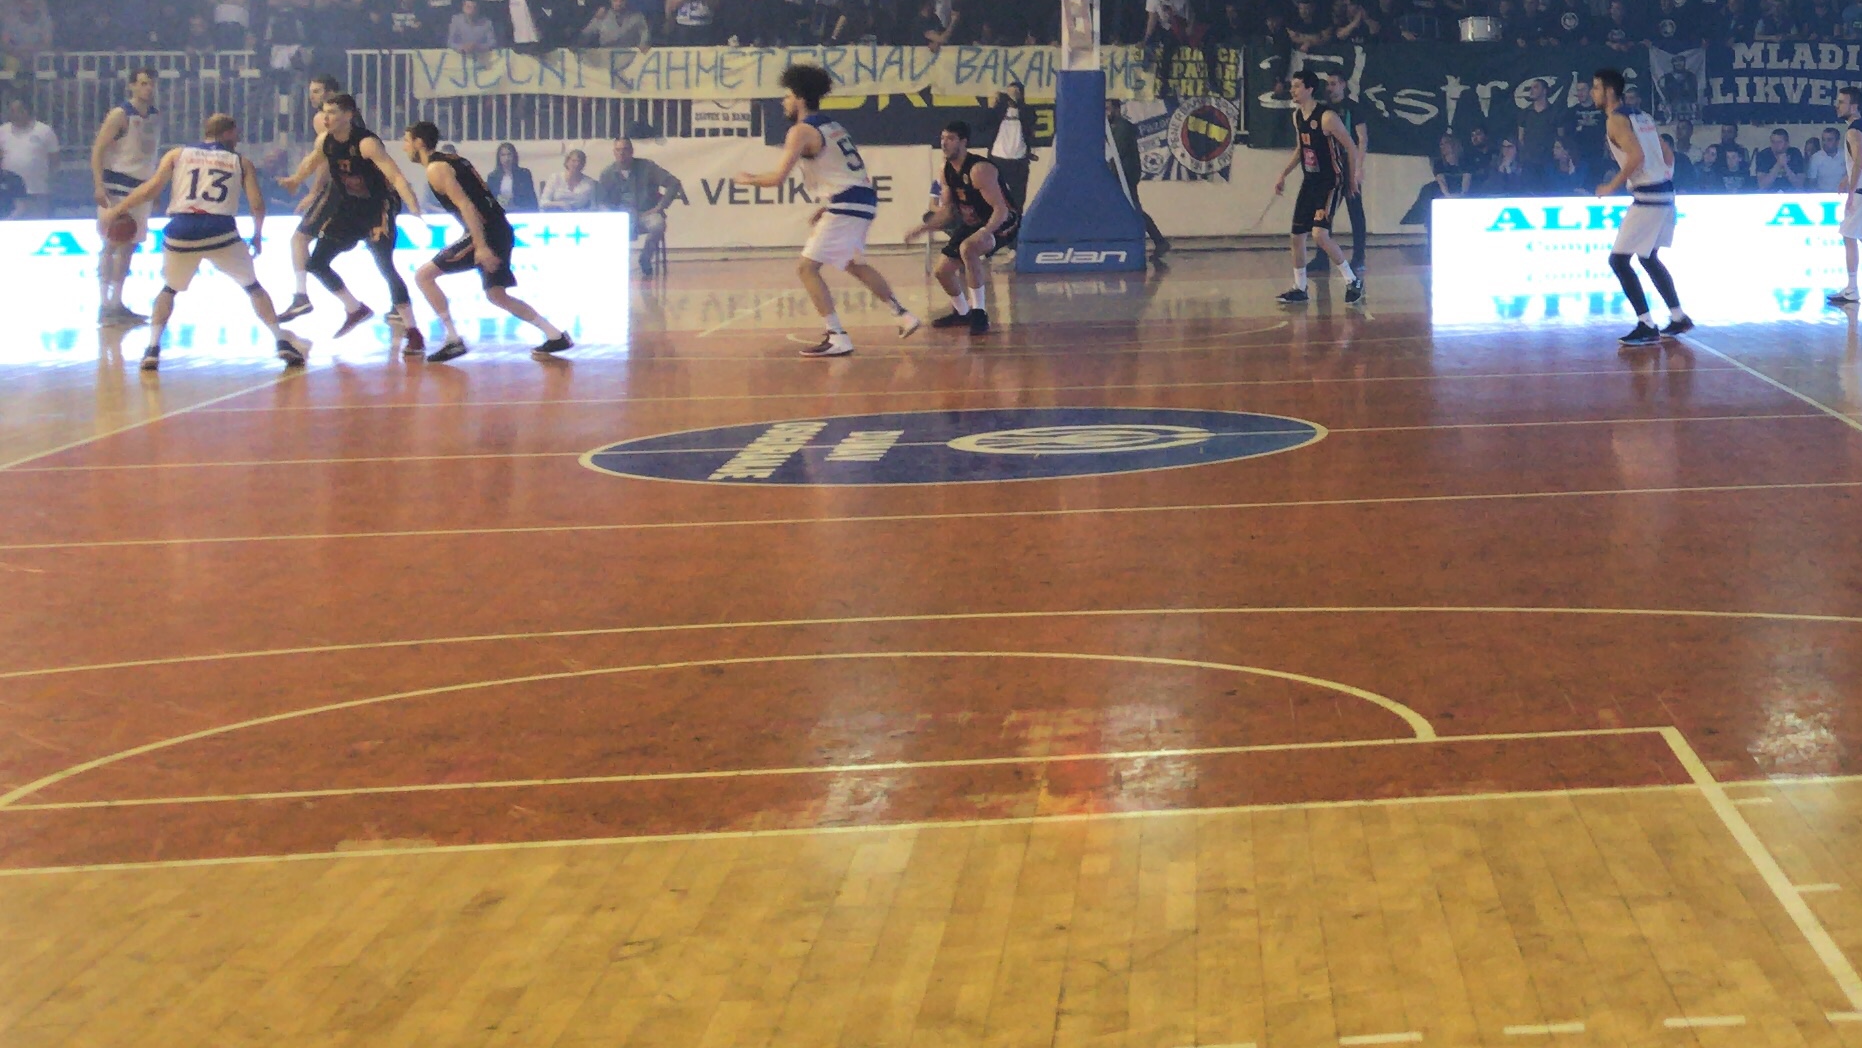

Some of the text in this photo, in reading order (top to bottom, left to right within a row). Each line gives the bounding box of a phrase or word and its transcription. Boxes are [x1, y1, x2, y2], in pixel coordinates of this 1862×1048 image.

[609, 48, 775, 90] RAHMET
[1732, 42, 1860, 71] MLAĐI
[185, 167, 234, 202] 13
[701, 176, 893, 206] VELIKE
[1035, 247, 1128, 265] elan
